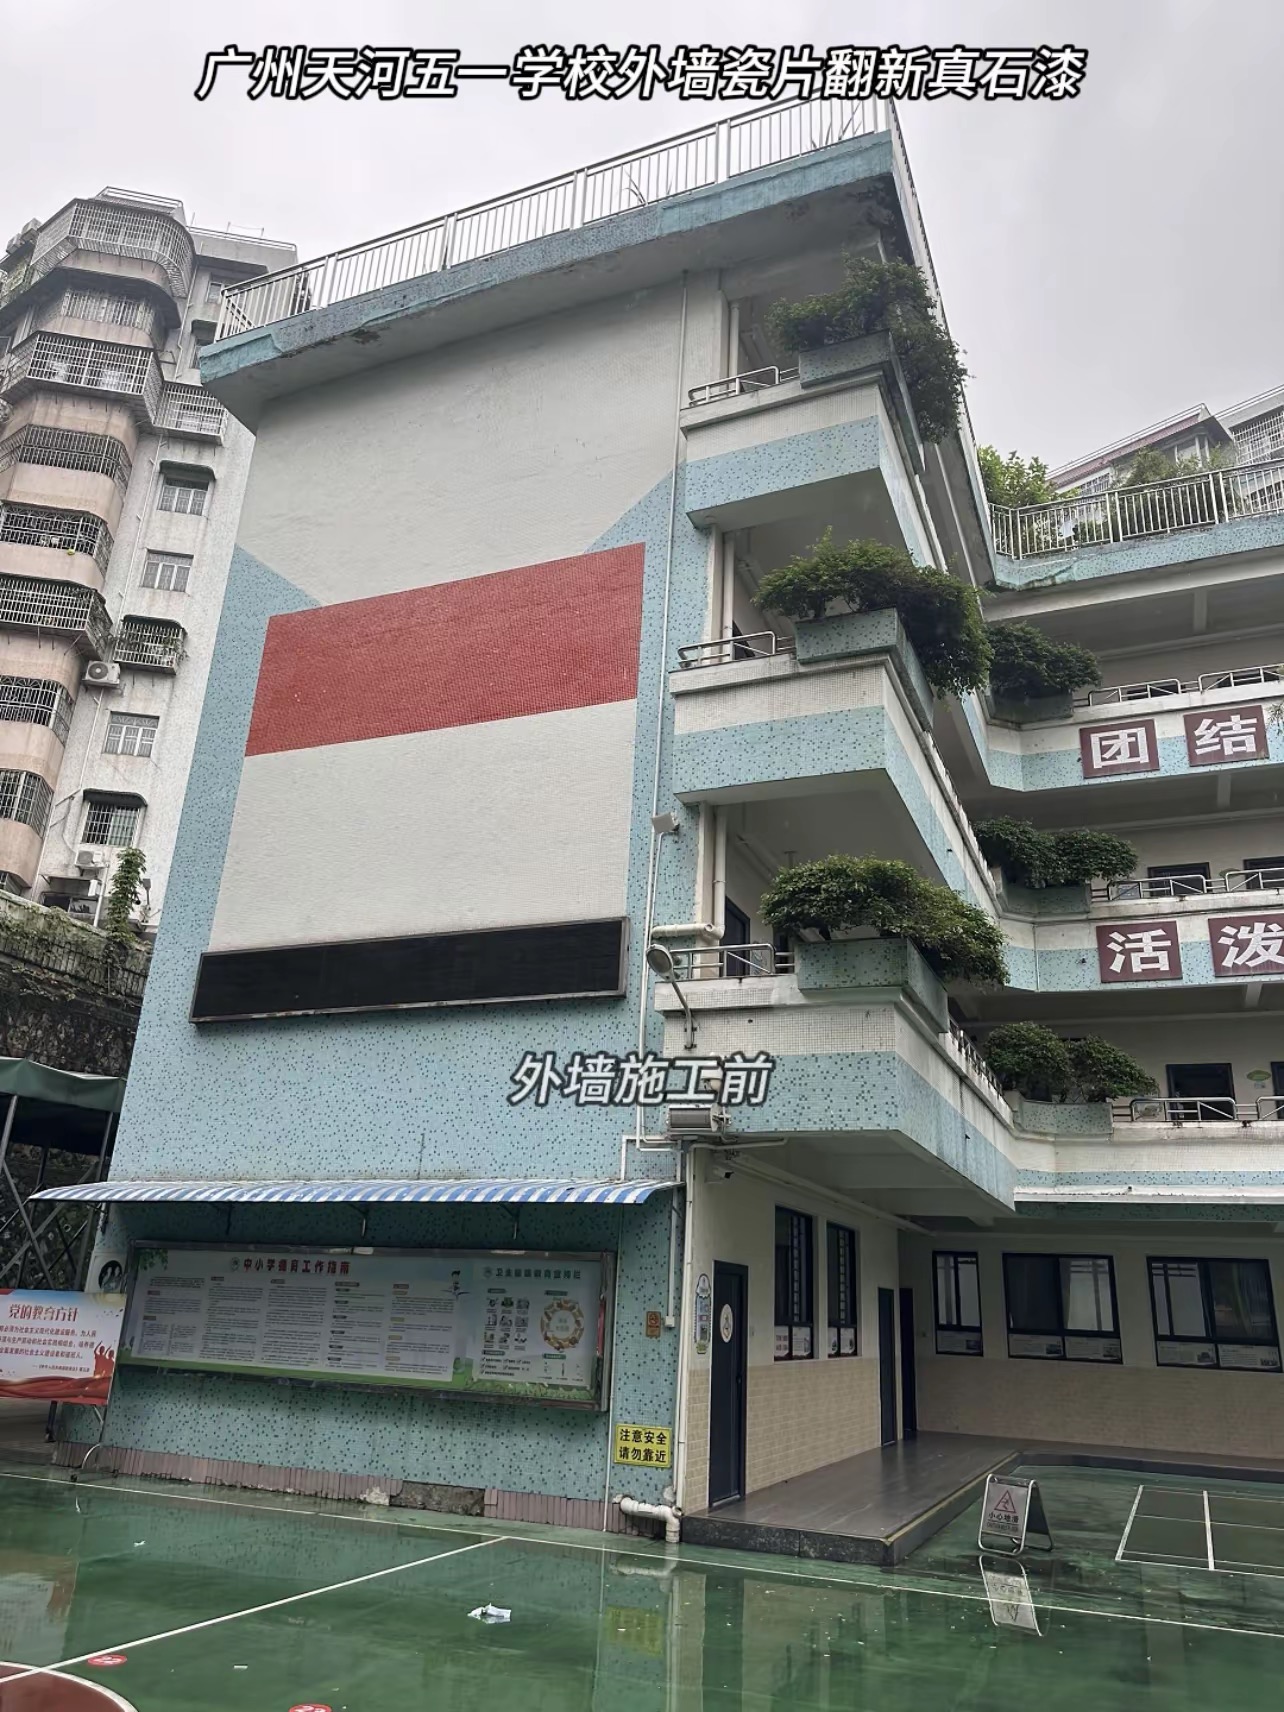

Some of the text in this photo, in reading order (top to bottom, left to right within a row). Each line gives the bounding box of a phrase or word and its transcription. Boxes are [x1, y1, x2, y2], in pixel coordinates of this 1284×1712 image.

[9, 1303, 78, 1322] 党的教育方针
[620, 1428, 667, 1445] 注意安全
[619, 1446, 667, 1463] 请勿靠近
[988, 1511, 1019, 1523] 小心地滑
